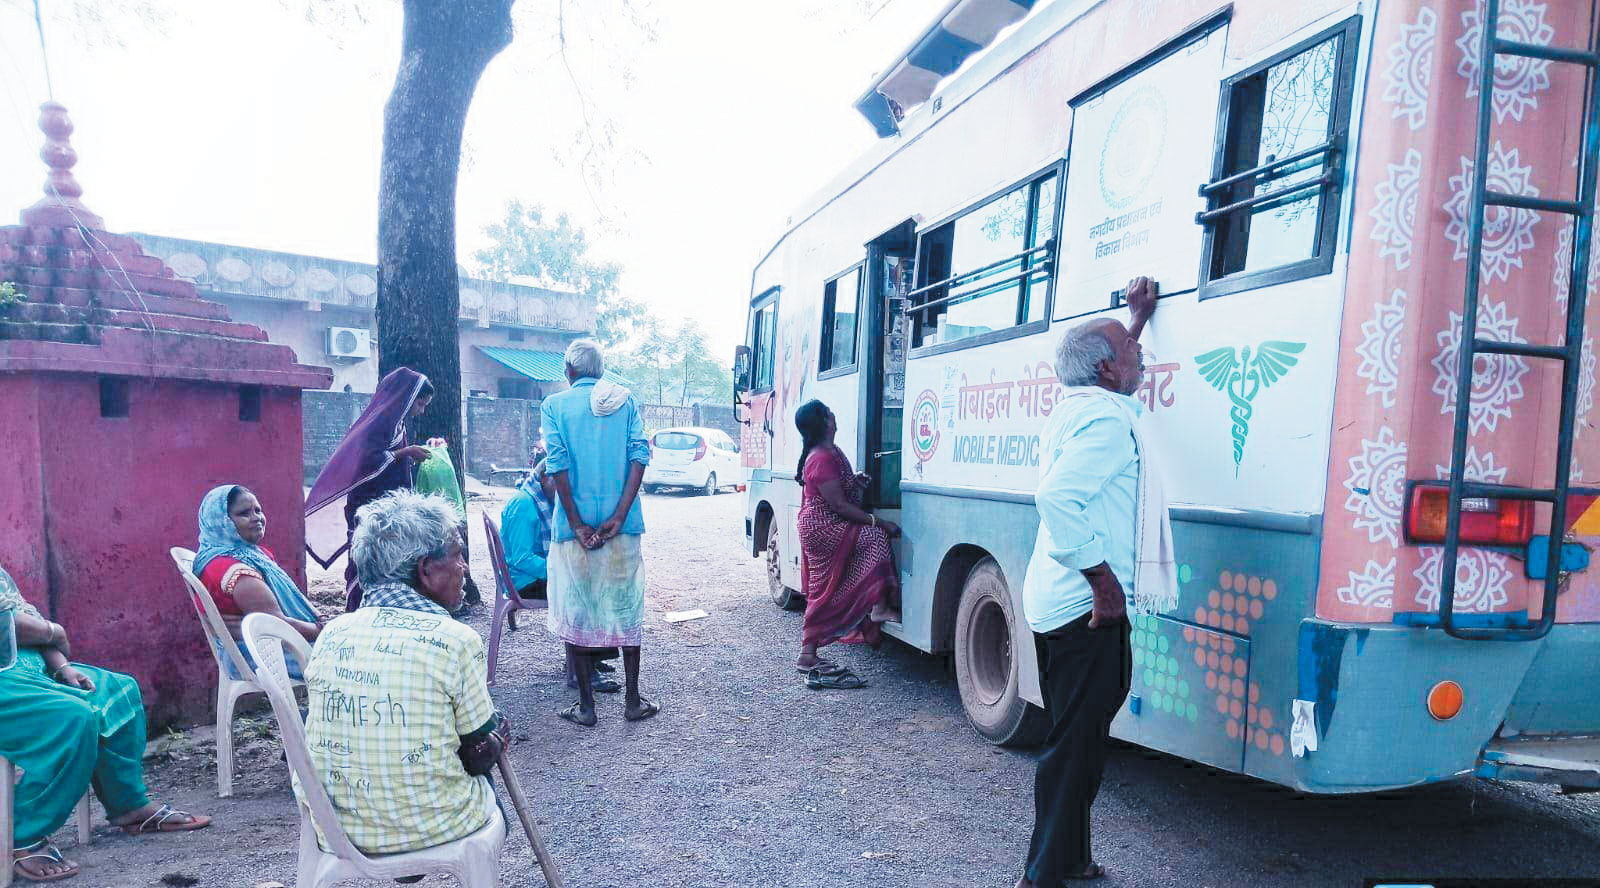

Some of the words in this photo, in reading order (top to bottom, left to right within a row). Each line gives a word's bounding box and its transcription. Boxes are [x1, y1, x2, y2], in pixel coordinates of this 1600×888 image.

[1095, 241, 1121, 260] विकास
[952, 435, 996, 464] MOBILE
[997, 434, 1040, 467] MEDIC
[335, 666, 379, 685] VANDANA
